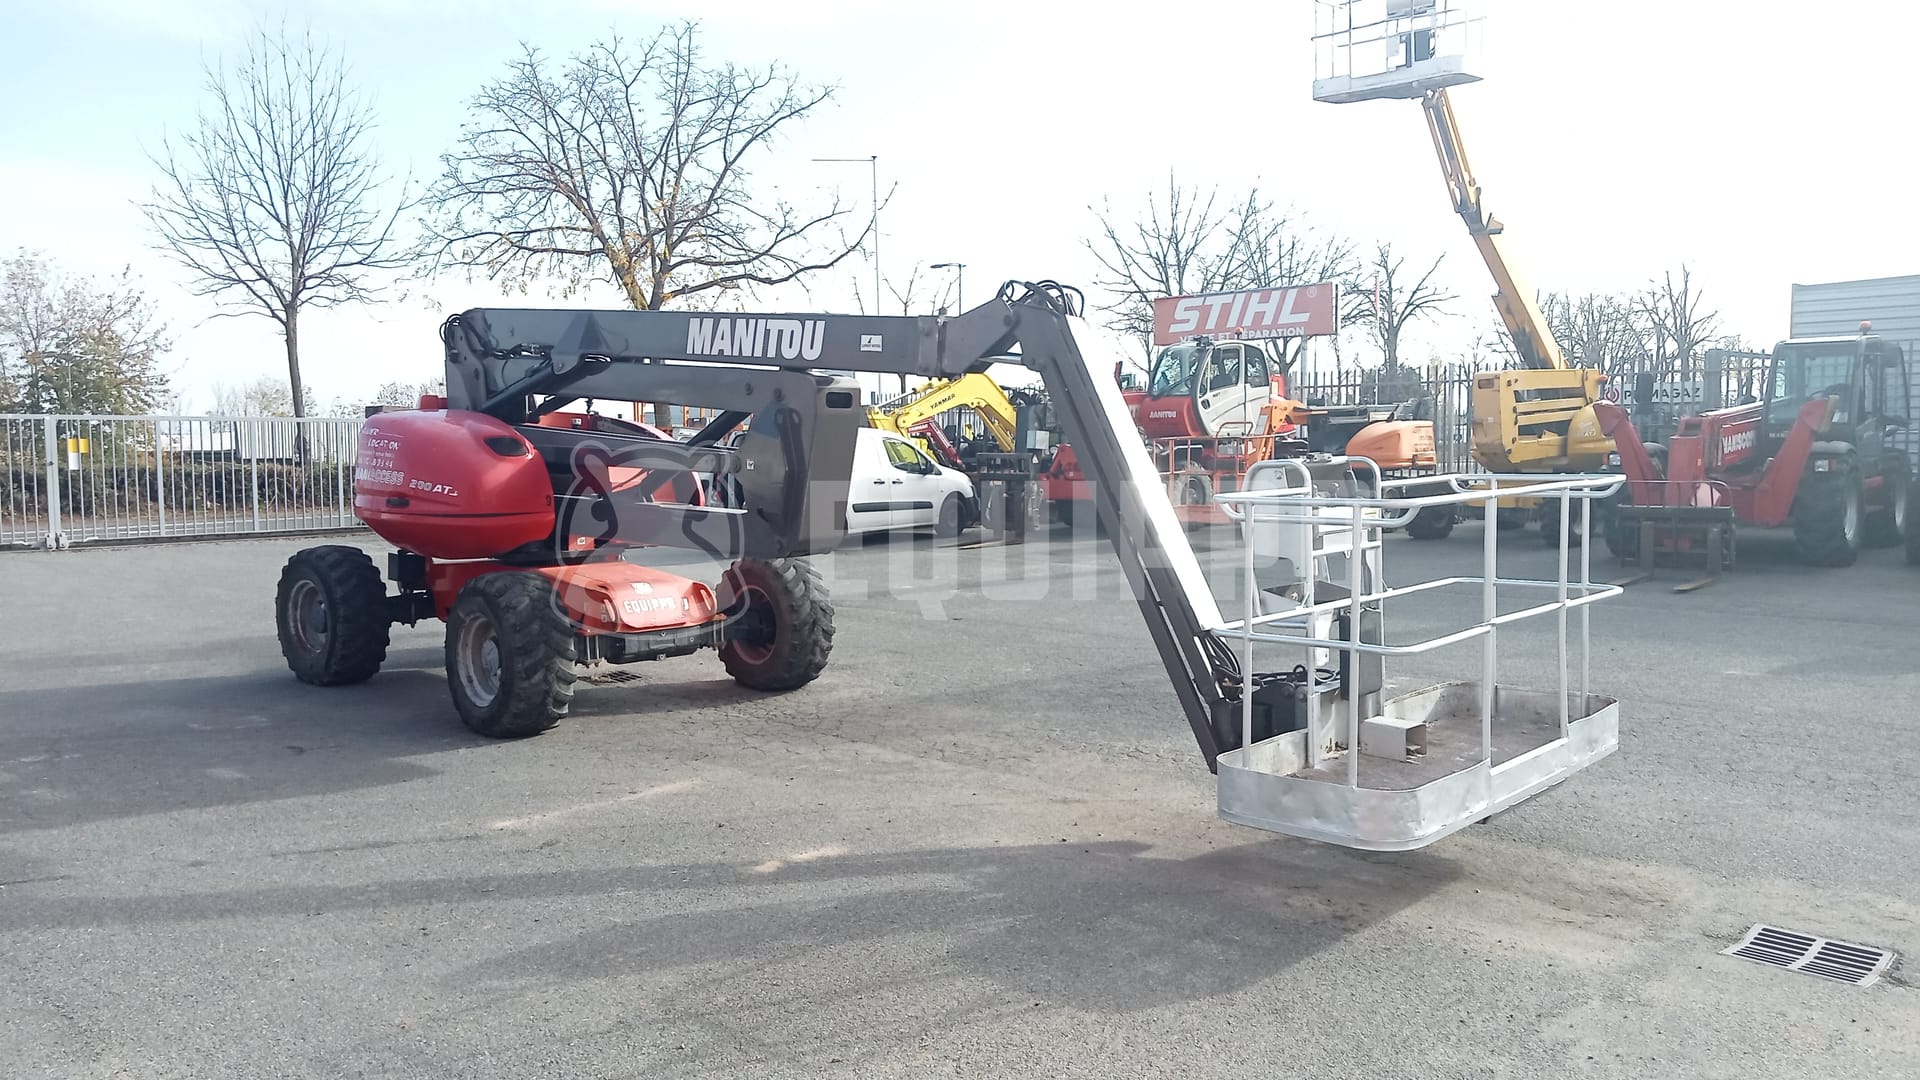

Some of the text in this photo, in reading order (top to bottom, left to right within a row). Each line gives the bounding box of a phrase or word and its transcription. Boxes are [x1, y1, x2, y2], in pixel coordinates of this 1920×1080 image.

[1168, 289, 1311, 334] STIHL
[686, 317, 826, 361] MANITOU
[1180, 326, 1305, 343] VEE ET ÉPARATION
[930, 393, 956, 410] YANMAR
